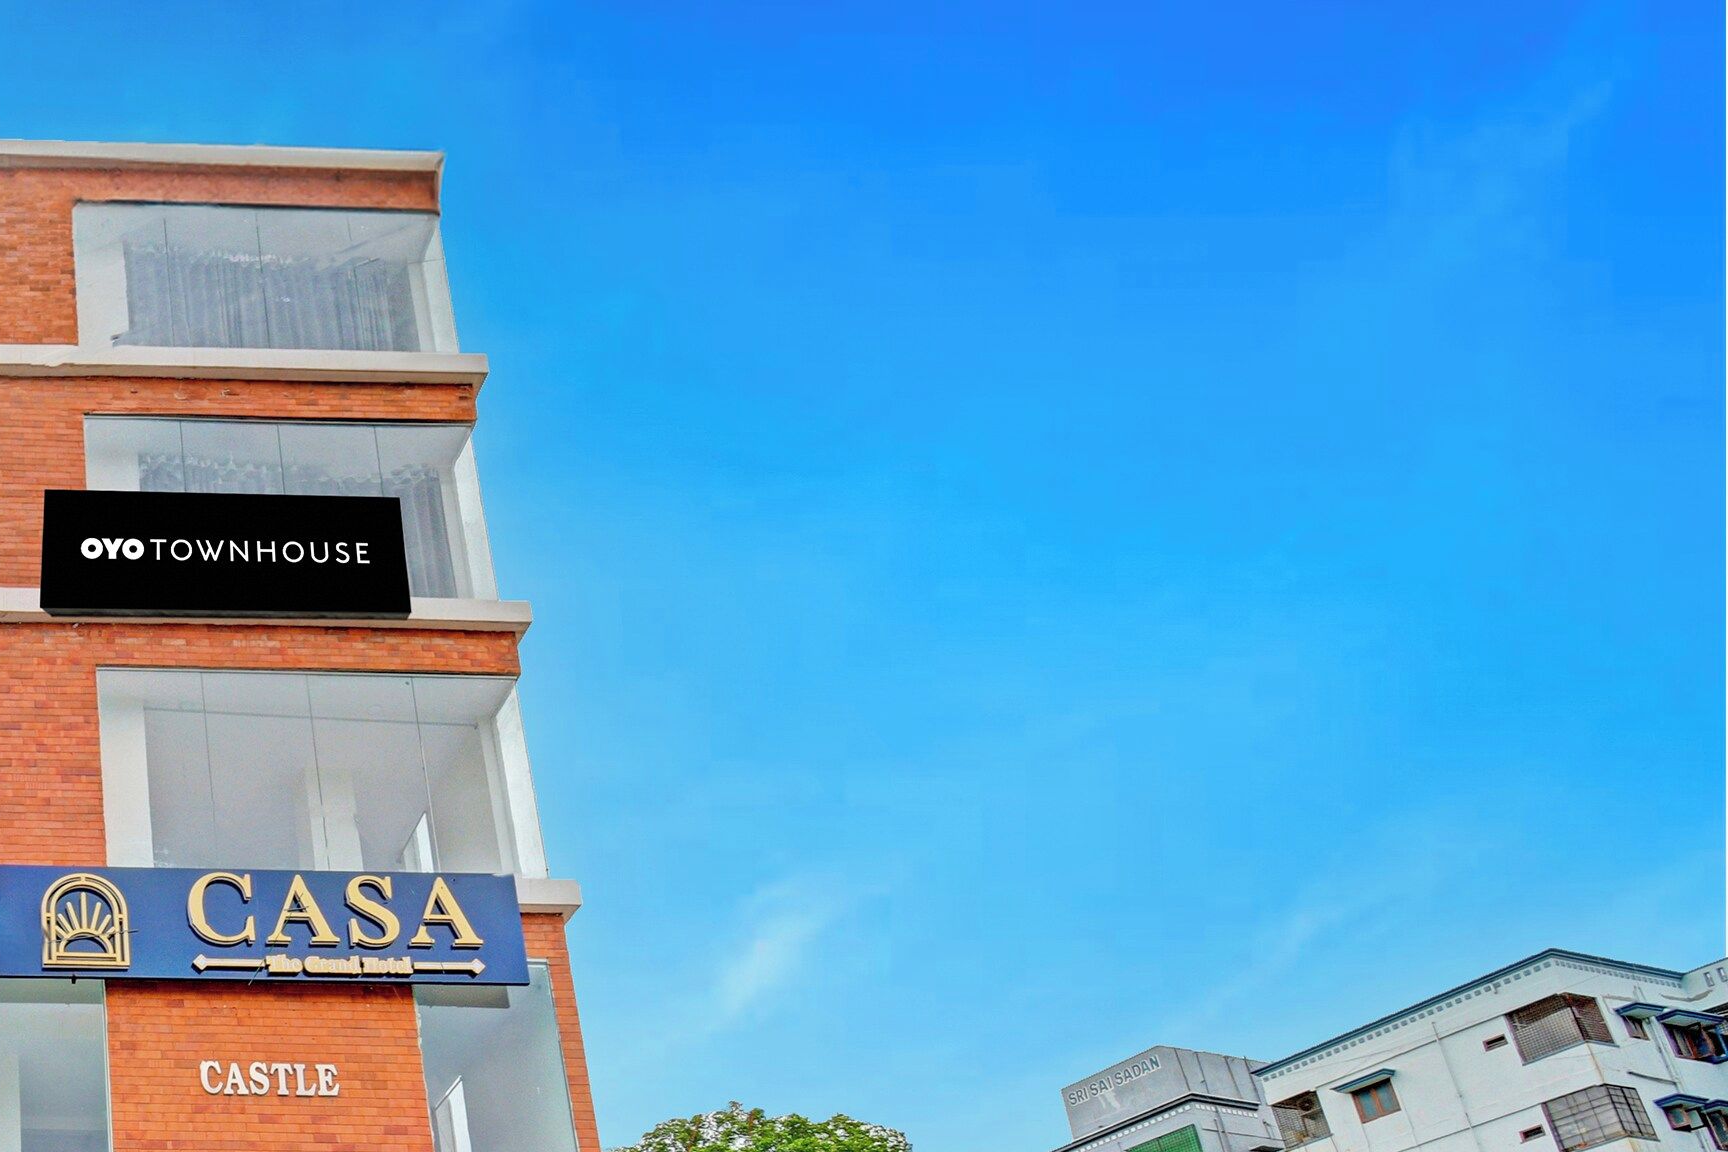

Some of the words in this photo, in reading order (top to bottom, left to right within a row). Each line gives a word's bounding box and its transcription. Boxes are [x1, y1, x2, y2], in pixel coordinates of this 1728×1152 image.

[80, 537, 145, 560] OYO
[149, 538, 371, 564] TOWNHOUSE
[186, 871, 484, 949] CASA
[265, 953, 304, 973] The
[304, 955, 362, 975] Grand
[199, 1060, 341, 1097] CASTLE
[1068, 1087, 1088, 1106] SRI
[1089, 1076, 1113, 1097] SAI
[1114, 1055, 1161, 1086] SADAN
